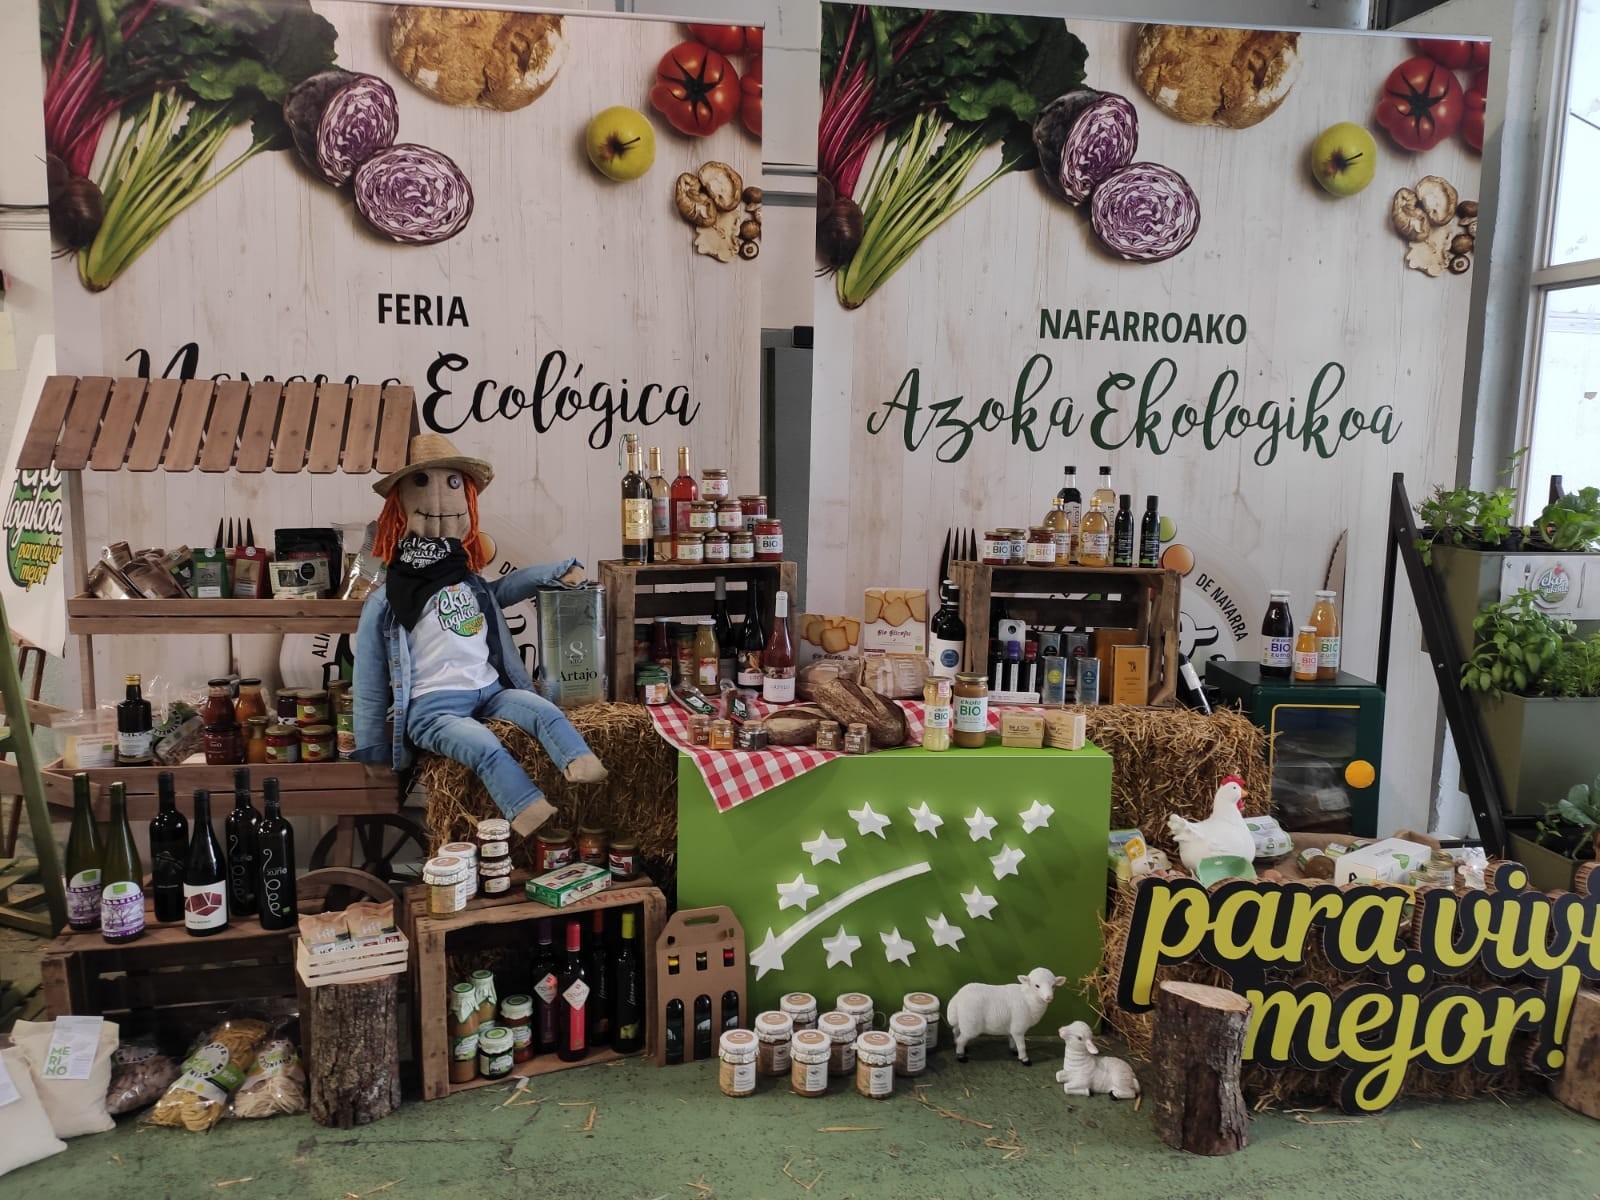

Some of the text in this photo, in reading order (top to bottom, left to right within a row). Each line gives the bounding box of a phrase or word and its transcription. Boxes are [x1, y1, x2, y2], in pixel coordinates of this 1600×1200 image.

[377, 293, 470, 328] FERIA
[1039, 308, 1248, 346] NAFARROAKO
[422, 350, 701, 450] Ecológica
[867, 353, 1403, 467] Azoka Ekologikoa
[762, 540, 778, 548] BIO
[993, 545, 1008, 554] BIO
[440, 591, 470, 615] eko
[1195, 573, 1249, 643] DE NAVARRA
[438, 606, 478, 631] logiko
[1271, 643, 1291, 653] BIO
[560, 667, 598, 682] Artajo
[934, 712, 949, 721] BIO
[959, 705, 982, 716] BIO
[1132, 886, 1408, 1006] para
[1242, 964, 1581, 1111] mejor!
[46, 1066, 68, 1076] NO
